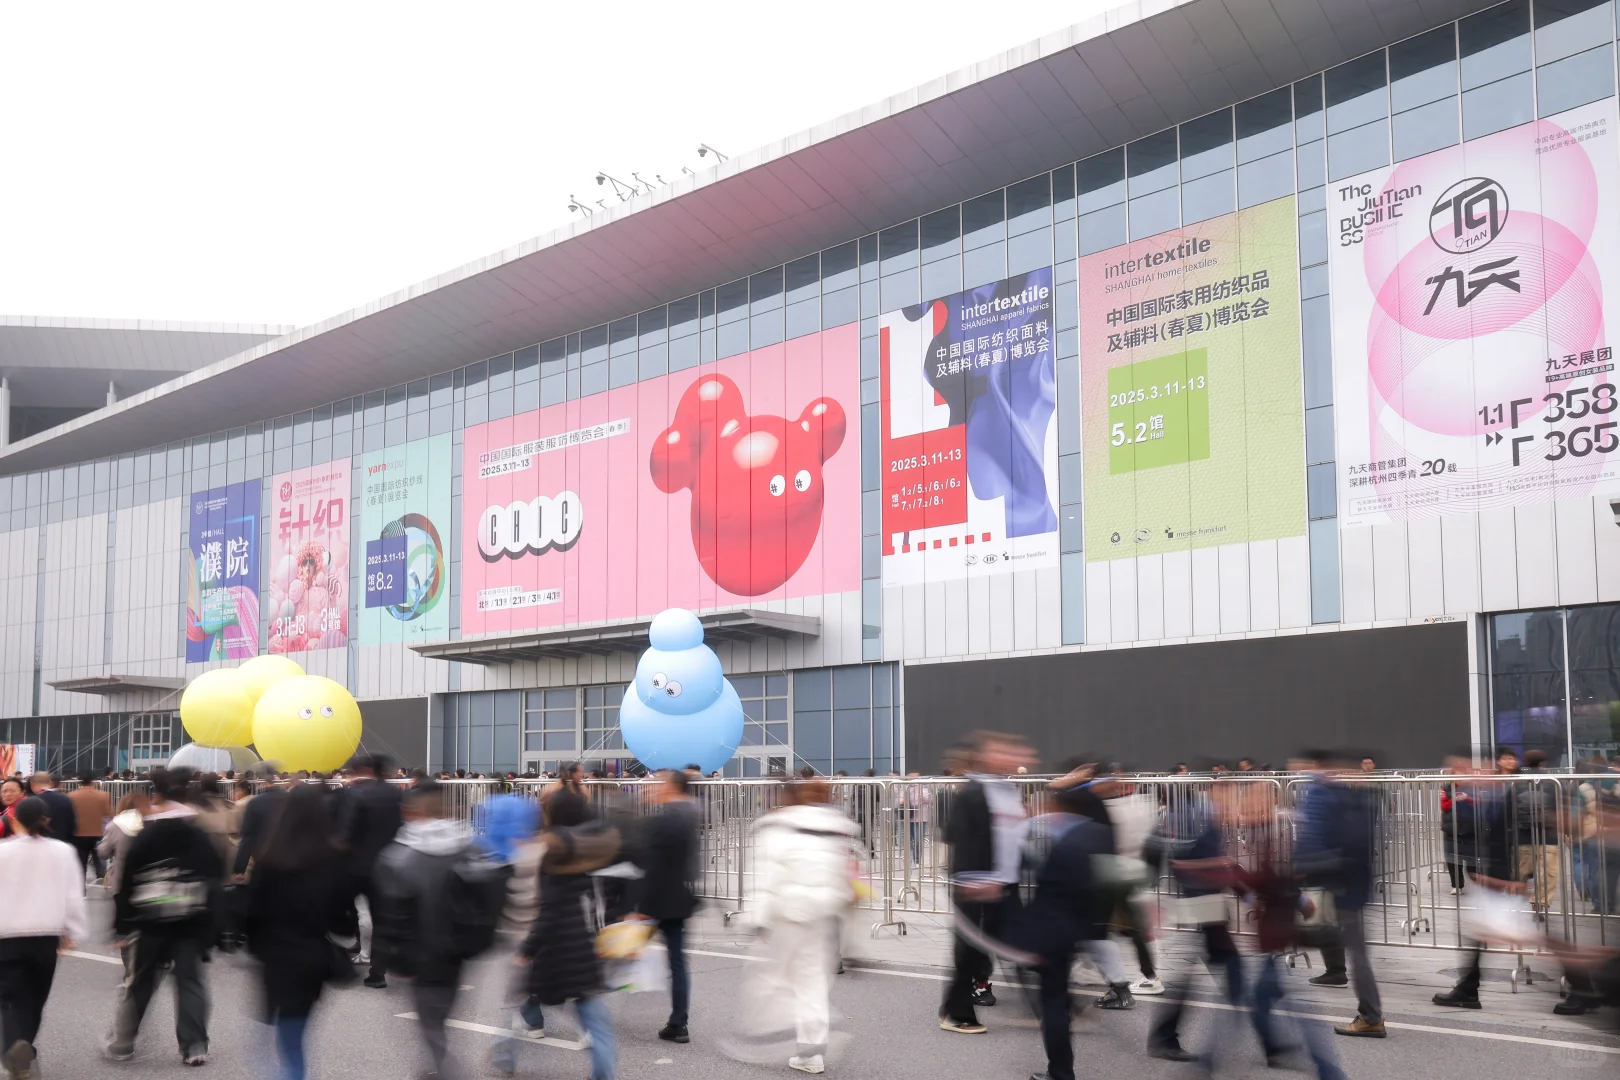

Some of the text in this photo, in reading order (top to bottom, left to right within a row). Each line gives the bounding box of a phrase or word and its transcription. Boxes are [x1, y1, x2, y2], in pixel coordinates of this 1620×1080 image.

[1105, 238, 1210, 279] intertextile
[1105, 258, 1218, 294] SHANGHAI home textiles
[1422, 255, 1520, 316] 九天
[962, 284, 1048, 320] intertextile
[1106, 270, 1270, 328] 中国国际家用纺织品
[962, 302, 1050, 330] SHANGHAI apparel fabrics
[1106, 297, 1270, 352] 及辅料(春夏)博览会
[936, 319, 1049, 361] 中国国际纺织面料
[936, 337, 1050, 378] 及辅料(春夏)博览会
[1546, 346, 1612, 372] 九天展团
[1110, 376, 1206, 407] 2025.3.11-13
[1112, 414, 1164, 446] 5.2 馆
[1150, 431, 1164, 440] Hall
[481, 459, 530, 476] 2025.3.11-13
[891, 449, 962, 472] 2025.3.11-13
[1348, 457, 1407, 475] 九天商管集团
[1349, 469, 1417, 488] 深耕杭州四季青
[279, 498, 344, 546] 针织
[490, 500, 568, 546] CHIC
[200, 536, 249, 582] 濮院
[368, 551, 404, 565] 2025.3.11-13
[376, 572, 393, 590] 8.2
[276, 615, 305, 637] 3.11-13
[320, 608, 328, 632] 3
